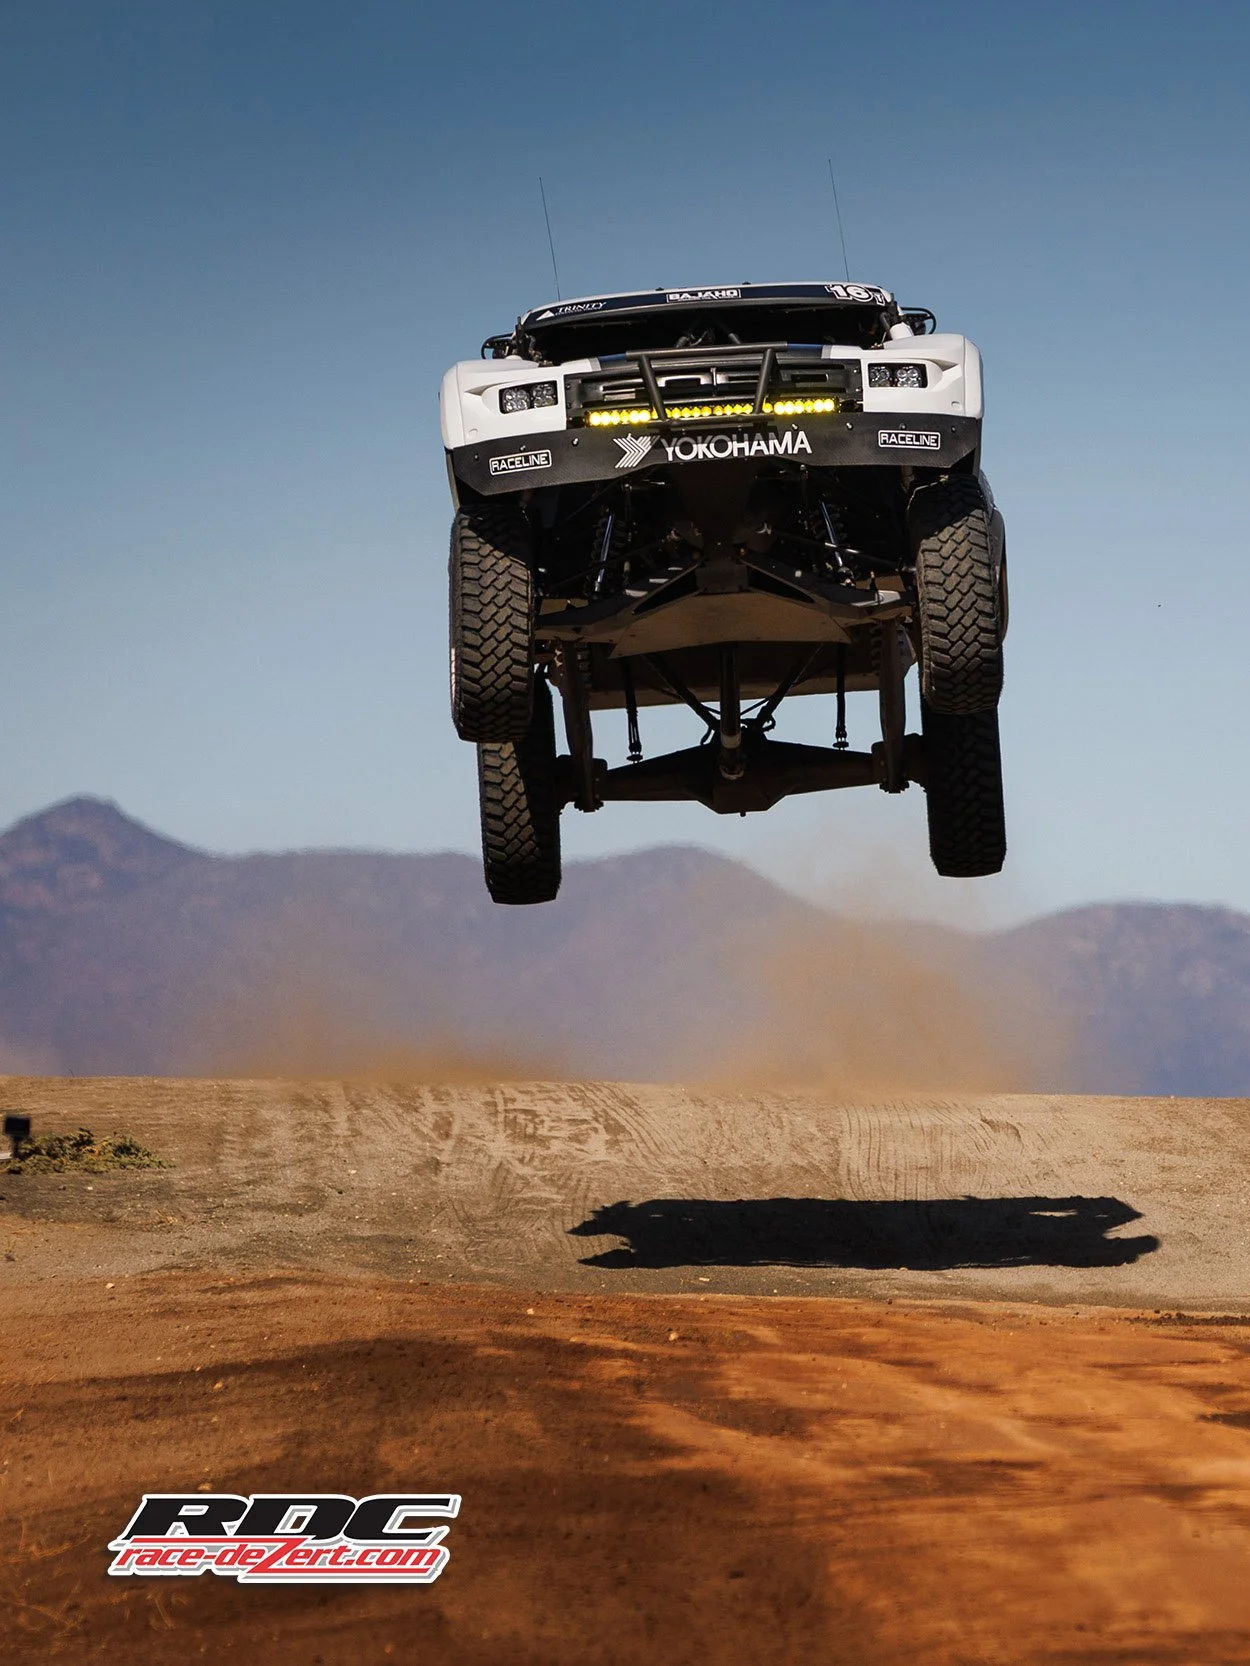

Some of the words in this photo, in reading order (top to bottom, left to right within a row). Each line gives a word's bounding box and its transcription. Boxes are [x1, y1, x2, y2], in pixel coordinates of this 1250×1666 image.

[557, 301, 607, 313] TRINITY
[662, 431, 812, 461] YOKOHAMA
[880, 433, 938, 447] RACELINE
[491, 453, 549, 472] RACELINE
